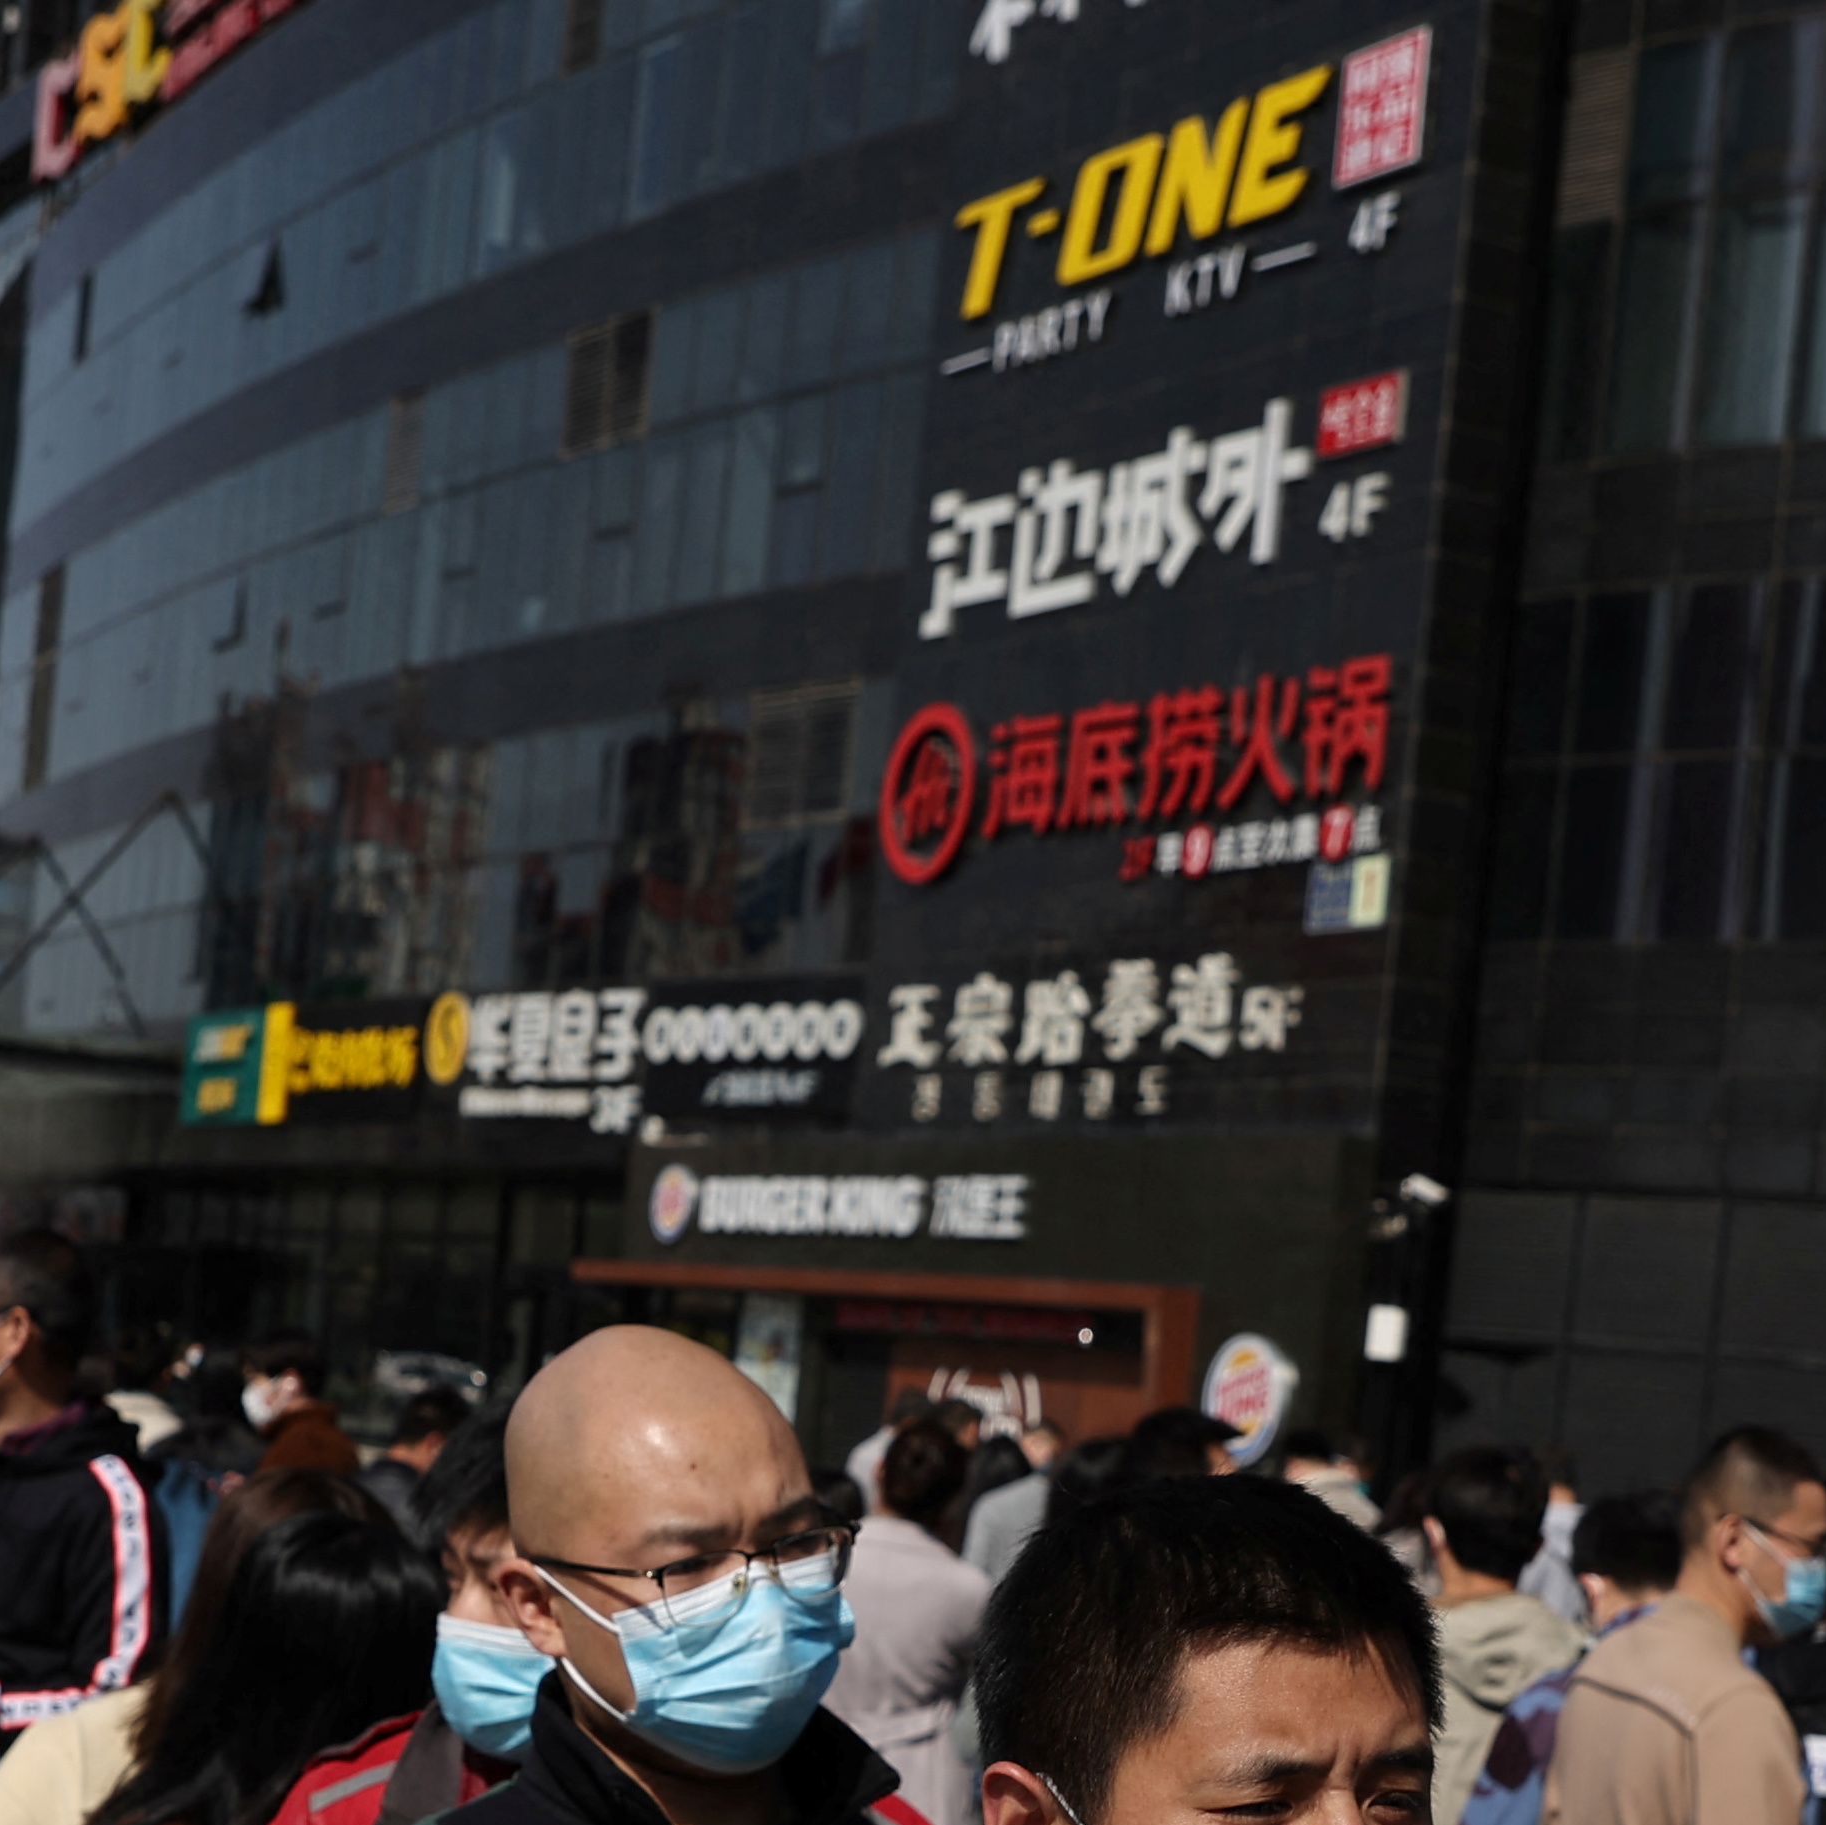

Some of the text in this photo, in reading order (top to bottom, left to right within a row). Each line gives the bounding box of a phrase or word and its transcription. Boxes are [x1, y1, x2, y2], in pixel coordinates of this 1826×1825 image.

[955, 64, 1333, 320] T-ONE
[1347, 191, 1401, 254] 4F
[991, 245, 1247, 373] PARTY KTV
[918, 397, 1313, 639] 江边城外
[1318, 472, 1391, 542] 4F
[981, 654, 1394, 840] 海底捞火锅
